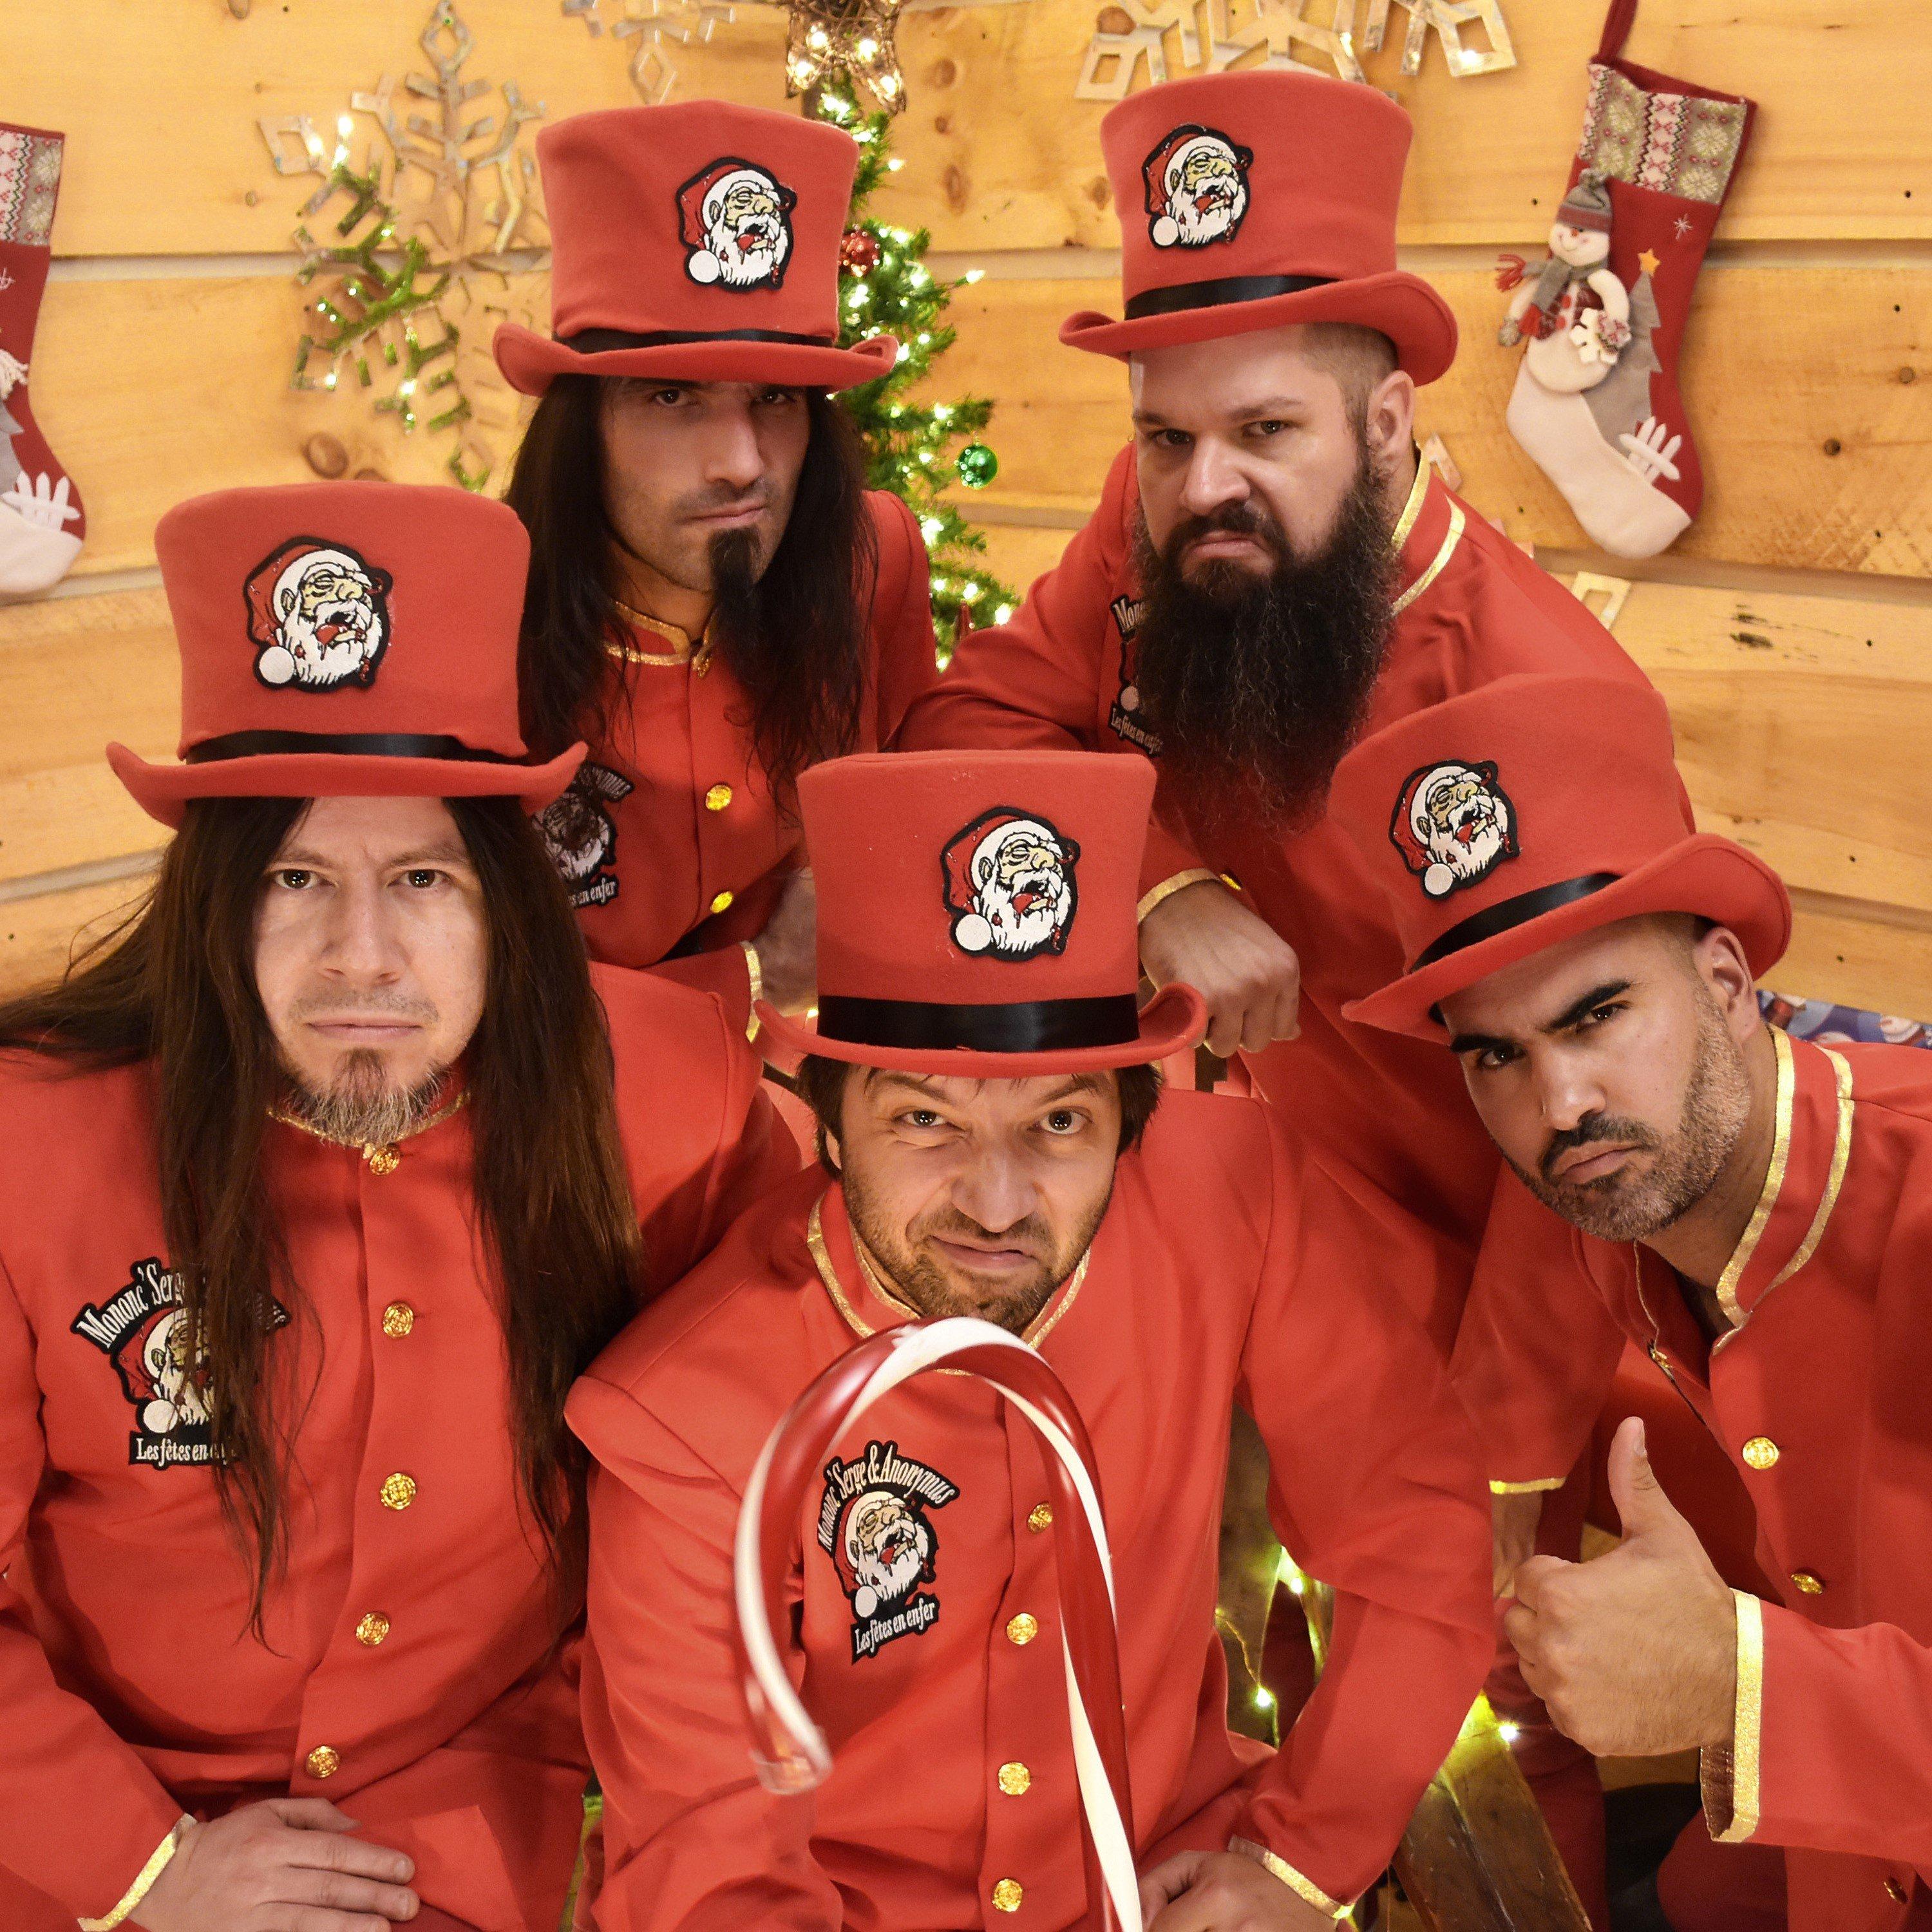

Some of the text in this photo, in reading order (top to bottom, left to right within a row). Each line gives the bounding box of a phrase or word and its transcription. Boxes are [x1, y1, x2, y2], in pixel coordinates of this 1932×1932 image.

[590, 877, 616, 903] enfer
[136, 1437, 159, 1461] Les
[158, 1437, 191, 1467] fêtes
[192, 1444, 209, 1461] en
[832, 1461, 867, 1500] Serge
[867, 1444, 880, 1484] &
[880, 1444, 956, 1504] Anonymus
[855, 1628, 871, 1654] Les
[893, 1613, 906, 1633] en
[906, 1597, 935, 1631] enfer
